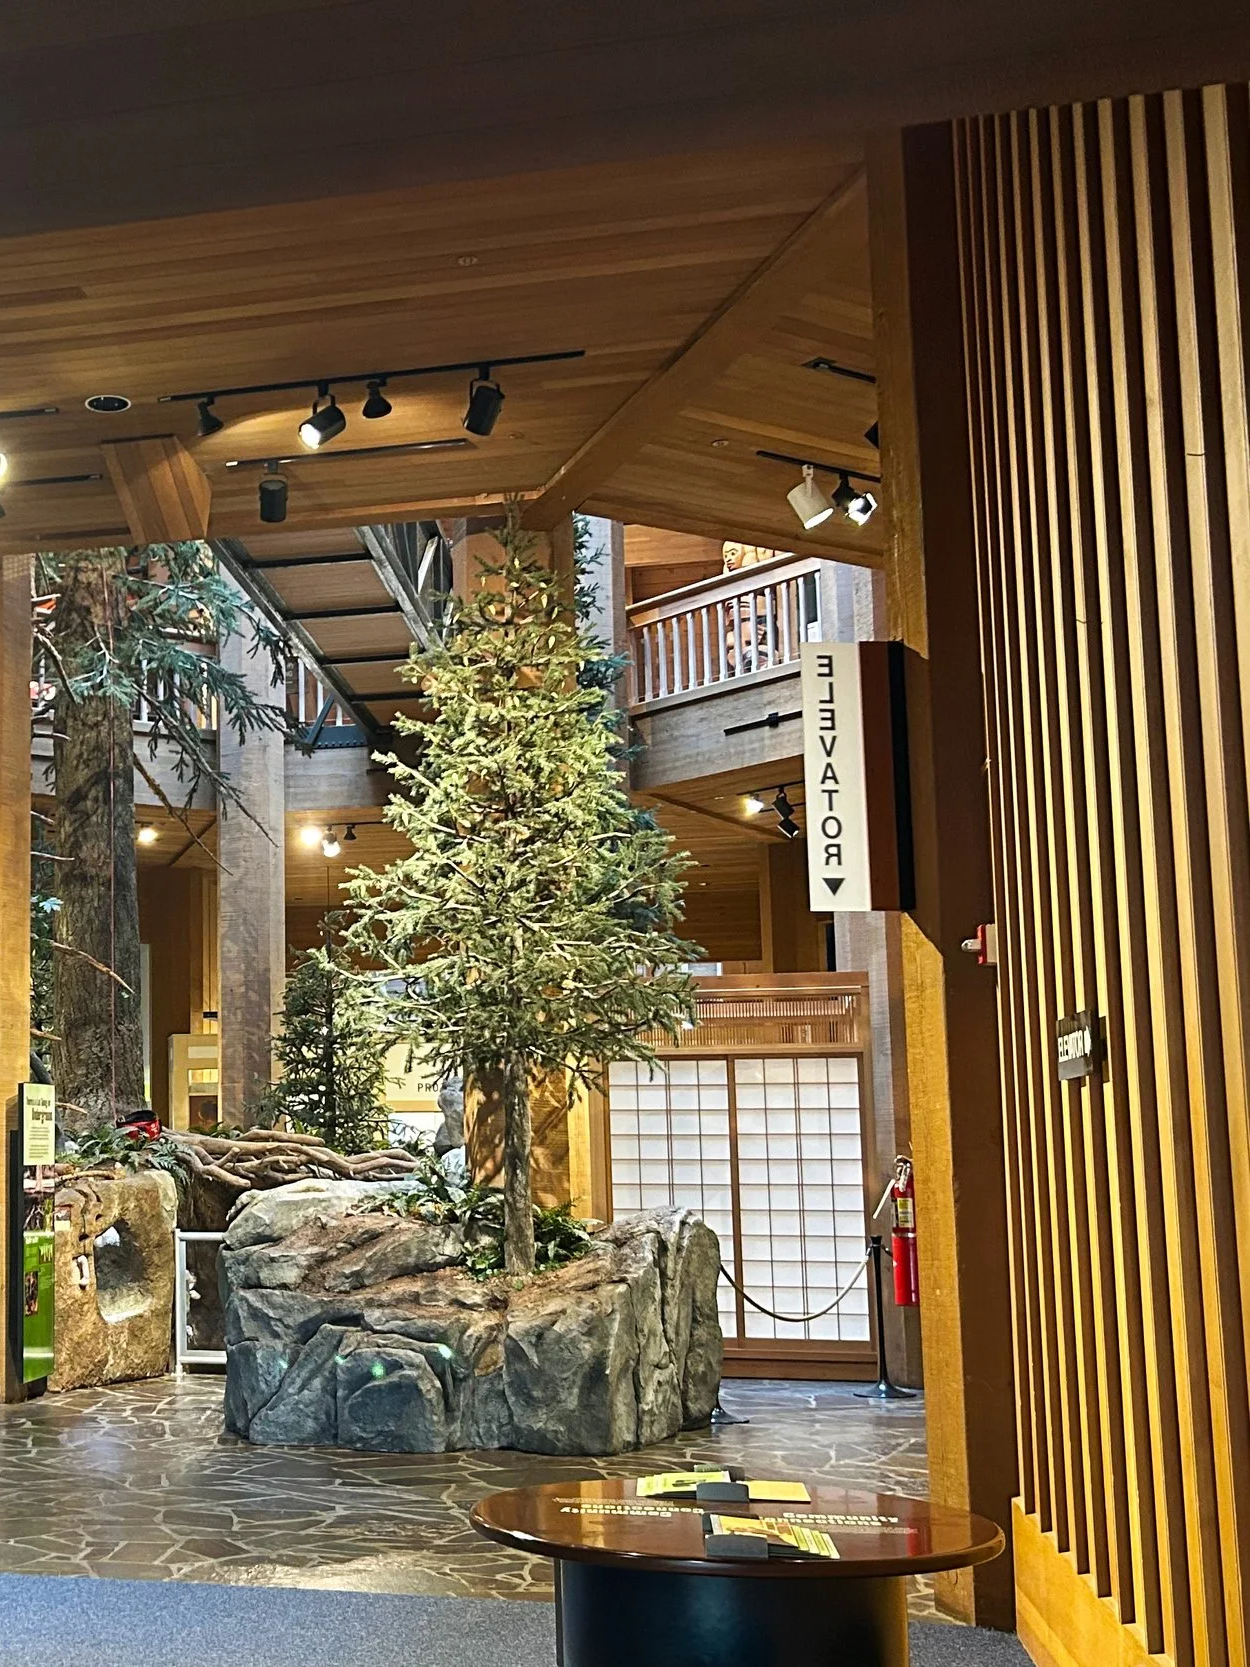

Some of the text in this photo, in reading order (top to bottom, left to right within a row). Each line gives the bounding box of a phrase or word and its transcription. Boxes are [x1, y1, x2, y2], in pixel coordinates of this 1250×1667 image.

[560, 1506, 672, 1518] Community
[782, 1512, 899, 1523] Community
[759, 1516, 882, 1526] onnections
